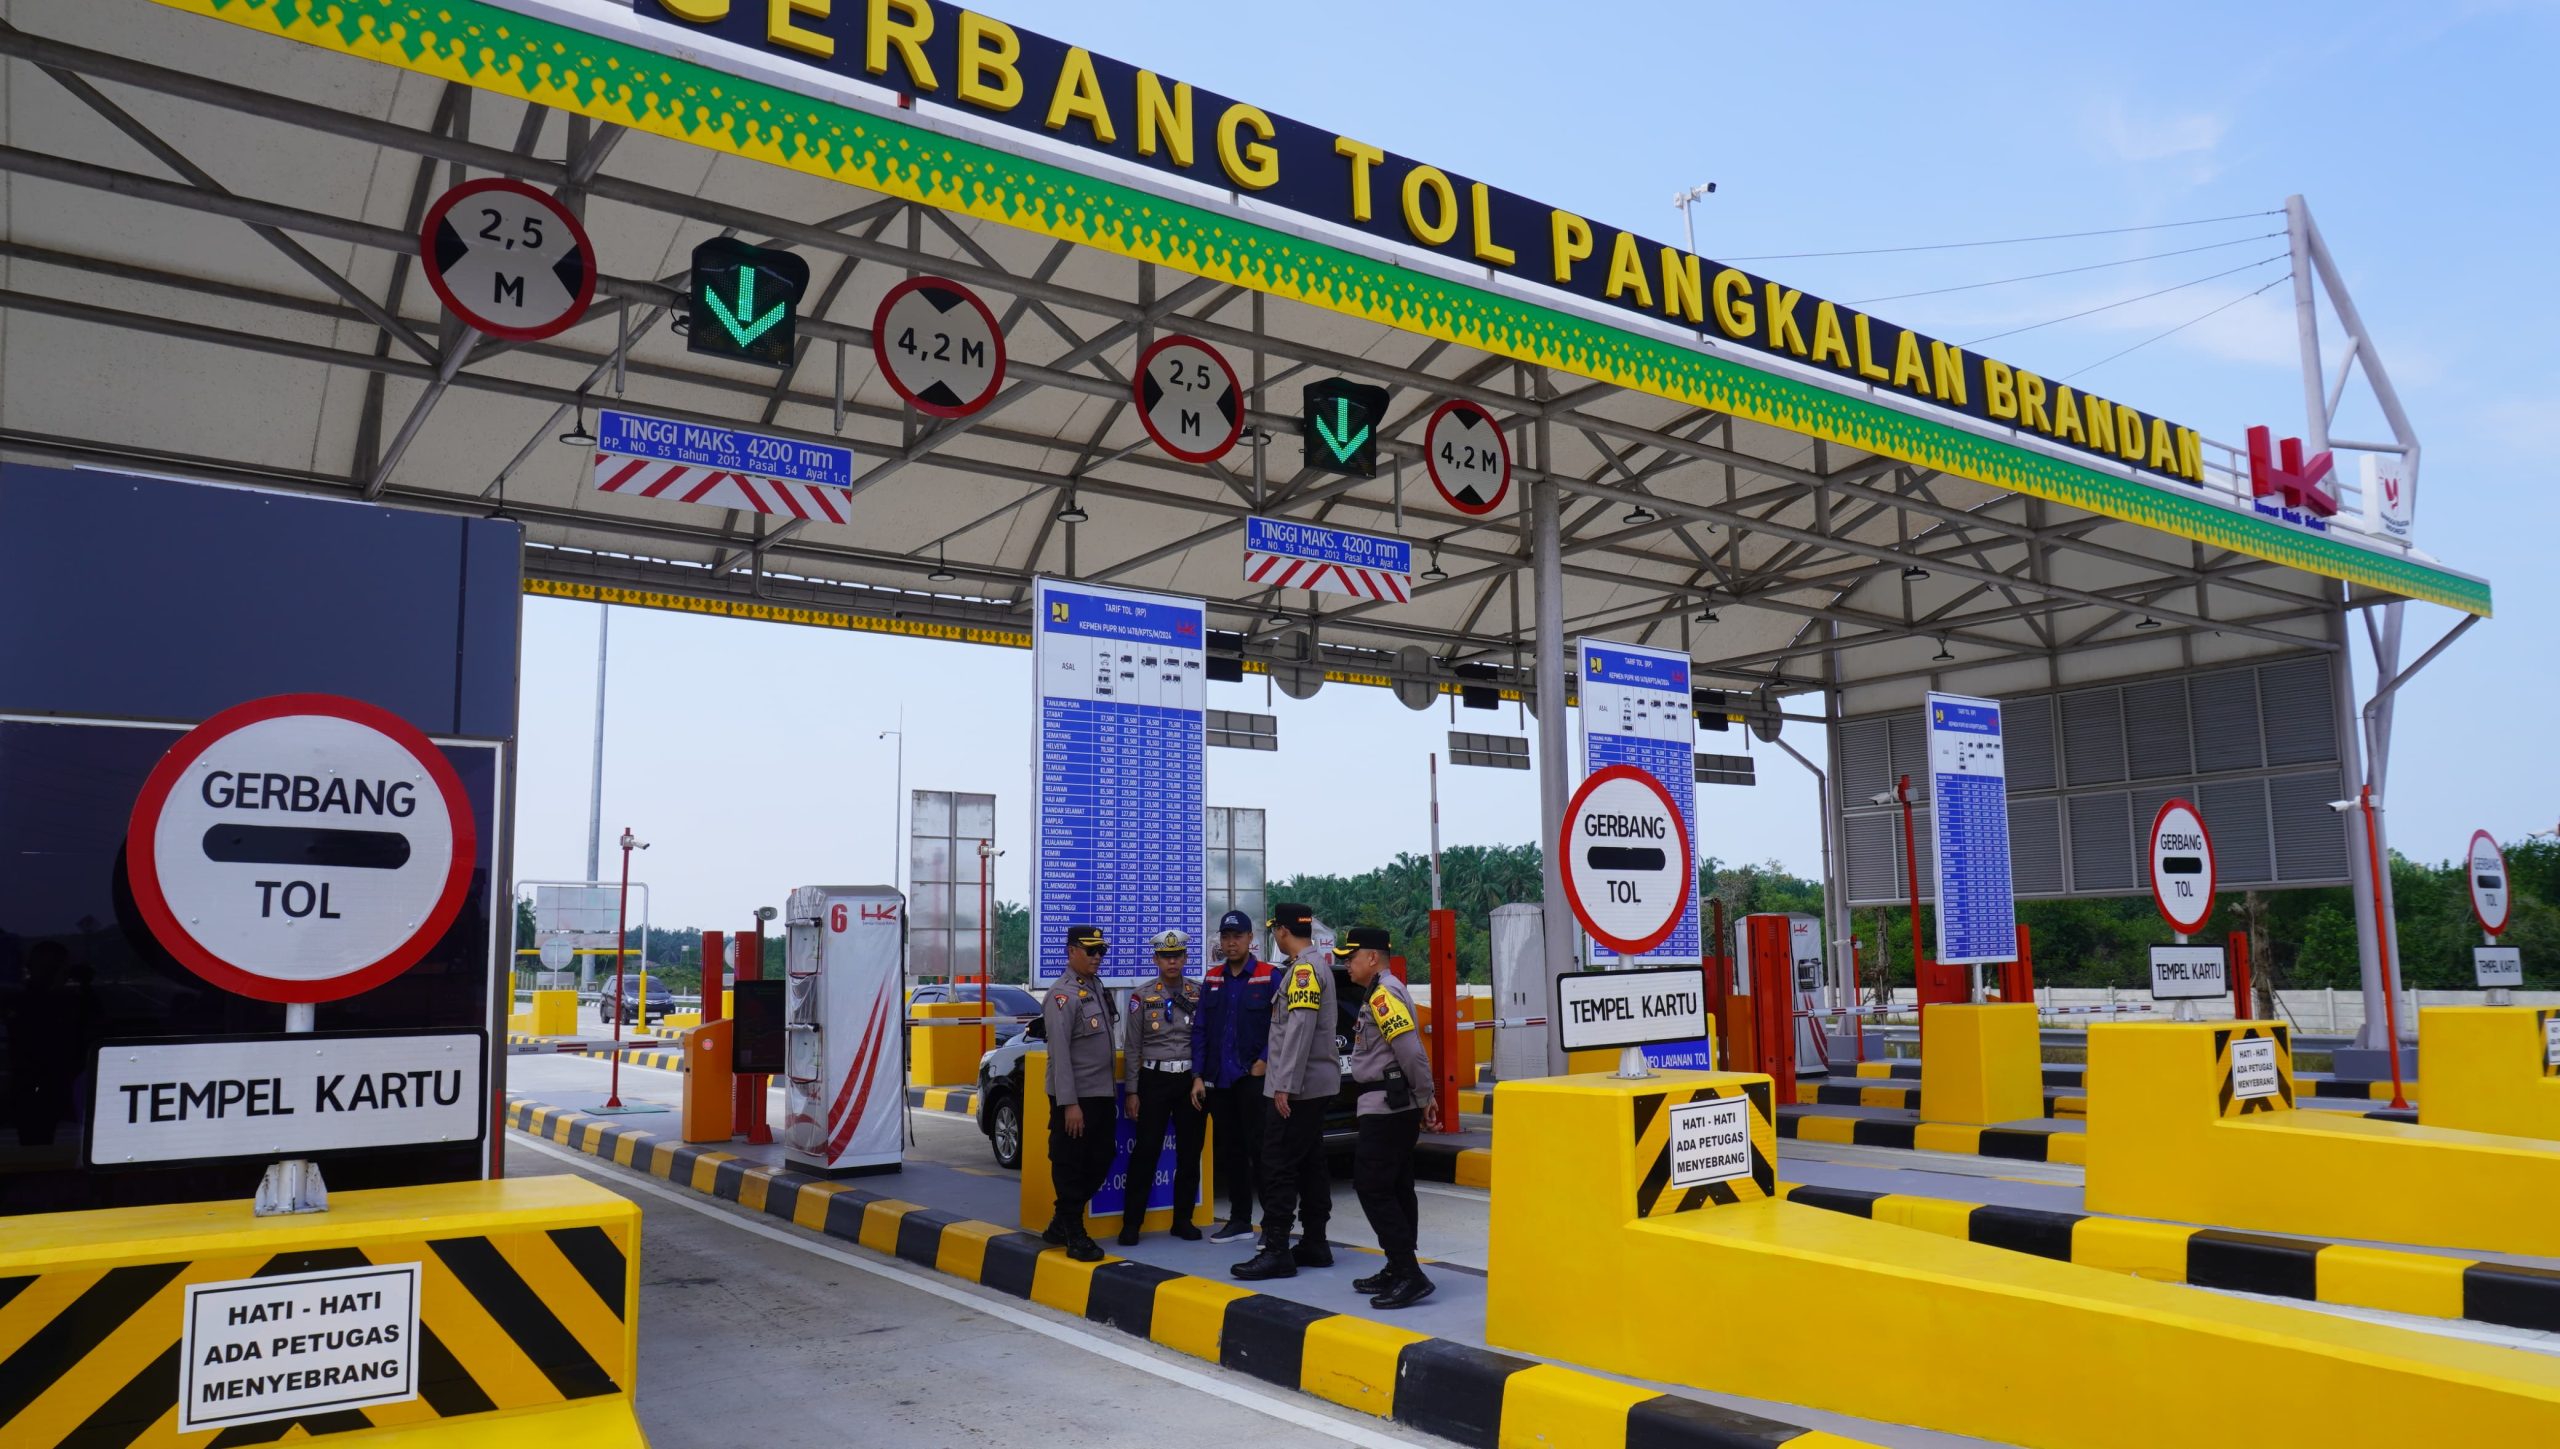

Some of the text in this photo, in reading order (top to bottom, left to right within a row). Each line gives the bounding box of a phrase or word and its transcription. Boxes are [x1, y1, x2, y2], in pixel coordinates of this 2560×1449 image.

[479, 208, 544, 249] 2,5
[494, 272, 524, 307] M
[1335, 136, 1516, 267] TOL
[1551, 209, 1967, 407] PANGKALAN
[1984, 357, 2203, 481] BRANDAN
[897, 327, 985, 369] 4,2 M
[1169, 359, 1212, 393] 2,5
[1180, 408, 1201, 437] M
[619, 416, 833, 470] TINGGI MAKS. 4200 mm
[604, 436, 622, 450] PP.
[630, 440, 649, 454] NO.
[658, 445, 671, 457] 55
[677, 447, 709, 463] Tahun
[717, 453, 741, 468] 2012
[749, 458, 777, 473] Pasal
[785, 464, 798, 476] 54
[806, 467, 827, 481] Ayat
[1441, 440, 1498, 477] 4,2 M
[1259, 521, 1398, 559] TINGGI MAKS. 4200 mm
[1250, 538, 1263, 548] PP.
[1267, 541, 1280, 551] NO.
[1286, 544, 1294, 553] 55
[1299, 546, 1320, 557] Tahun
[1324, 550, 1340, 560] 2012
[1345, 553, 1362, 564] Pasal
[1367, 557, 1375, 565] 54
[1380, 559, 1393, 569] Ayat
[1104, 603, 1147, 618] TARIF TOL (RP)
[1079, 621, 1102, 632] KEPMEN
[1102, 624, 1118, 633] PUPR
[1062, 662, 1076, 671] ASAL
[201, 770, 417, 818] GERBANG
[1045, 785, 1068, 793] BELAWAN
[1045, 806, 1064, 814] BANDAR
[1045, 817, 1064, 825] AMPLAS
[1584, 814, 1666, 839] GERBANG
[2160, 834, 2202, 851] GERBANG
[255, 880, 341, 920] TOL
[1051, 893, 1071, 901] RAMPAH
[1607, 880, 1641, 904] TOL
[2175, 880, 2193, 898] TOL
[831, 903, 848, 933] 6
[1042, 958, 1054, 966] LIMA
[2156, 961, 2221, 981] TEMPEL KARTU
[1569, 992, 1697, 1024] TEMPEL KARTU
[1394, 1019, 1409, 1030] RES
[1645, 1052, 1708, 1068] NFO LAYANAN TOL
[2239, 1050, 2252, 1058] HATI
[2256, 1048, 2268, 1057] HATI
[2237, 1062, 2273, 1073] ADA PETUGAS
[2238, 1077, 2274, 1088] MENYEBRANG
[120, 1069, 461, 1124] TEMPEL KARTU
[1682, 1114, 1704, 1131] HATI
[1715, 1111, 1736, 1127] HATI
[1676, 1131, 1744, 1152] ADA PETUGAS
[1677, 1152, 1745, 1173] MENYEBRANG
[228, 1299, 294, 1327] HATI
[319, 1291, 381, 1318] HATI
[203, 1323, 400, 1366] ADA PETUGAS
[202, 1359, 399, 1404] MENYEBRANG
